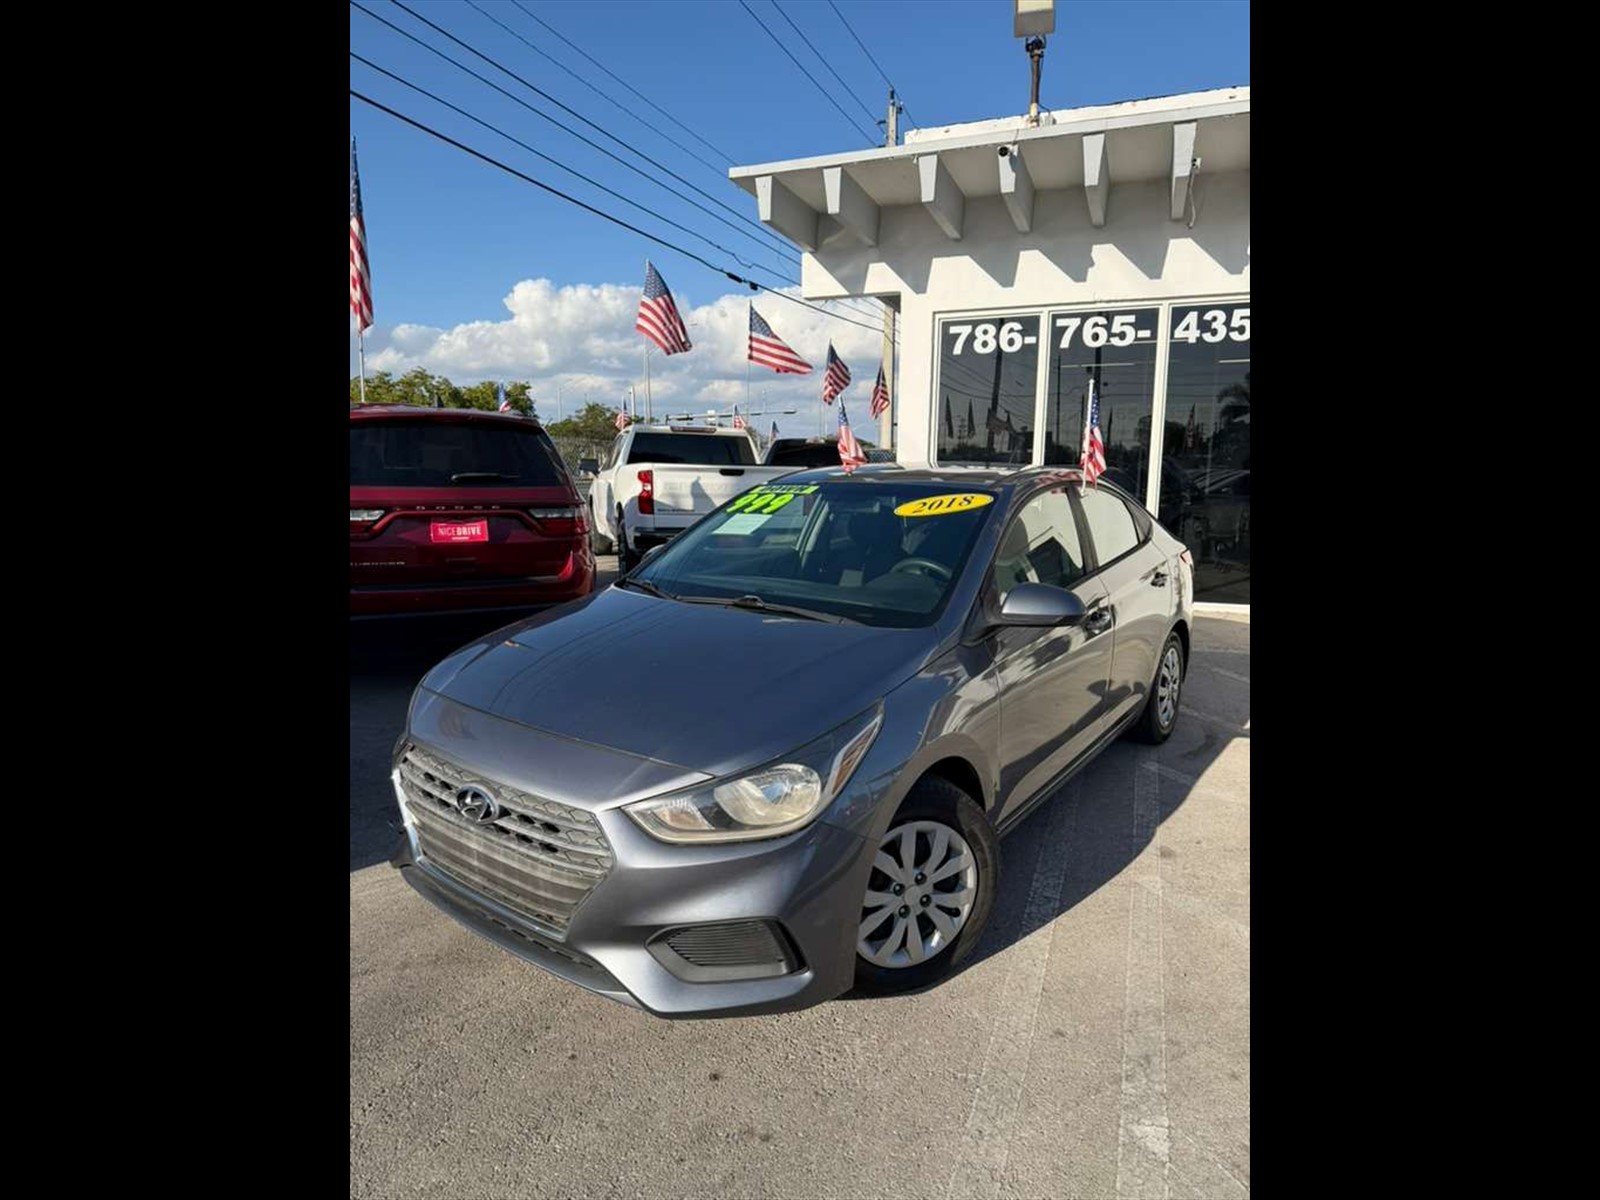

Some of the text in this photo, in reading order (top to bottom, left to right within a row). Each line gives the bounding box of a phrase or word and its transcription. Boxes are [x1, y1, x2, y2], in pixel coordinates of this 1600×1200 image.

[949, 308, 1250, 355] 786- 765- 435
[911, 495, 975, 514] 2018
